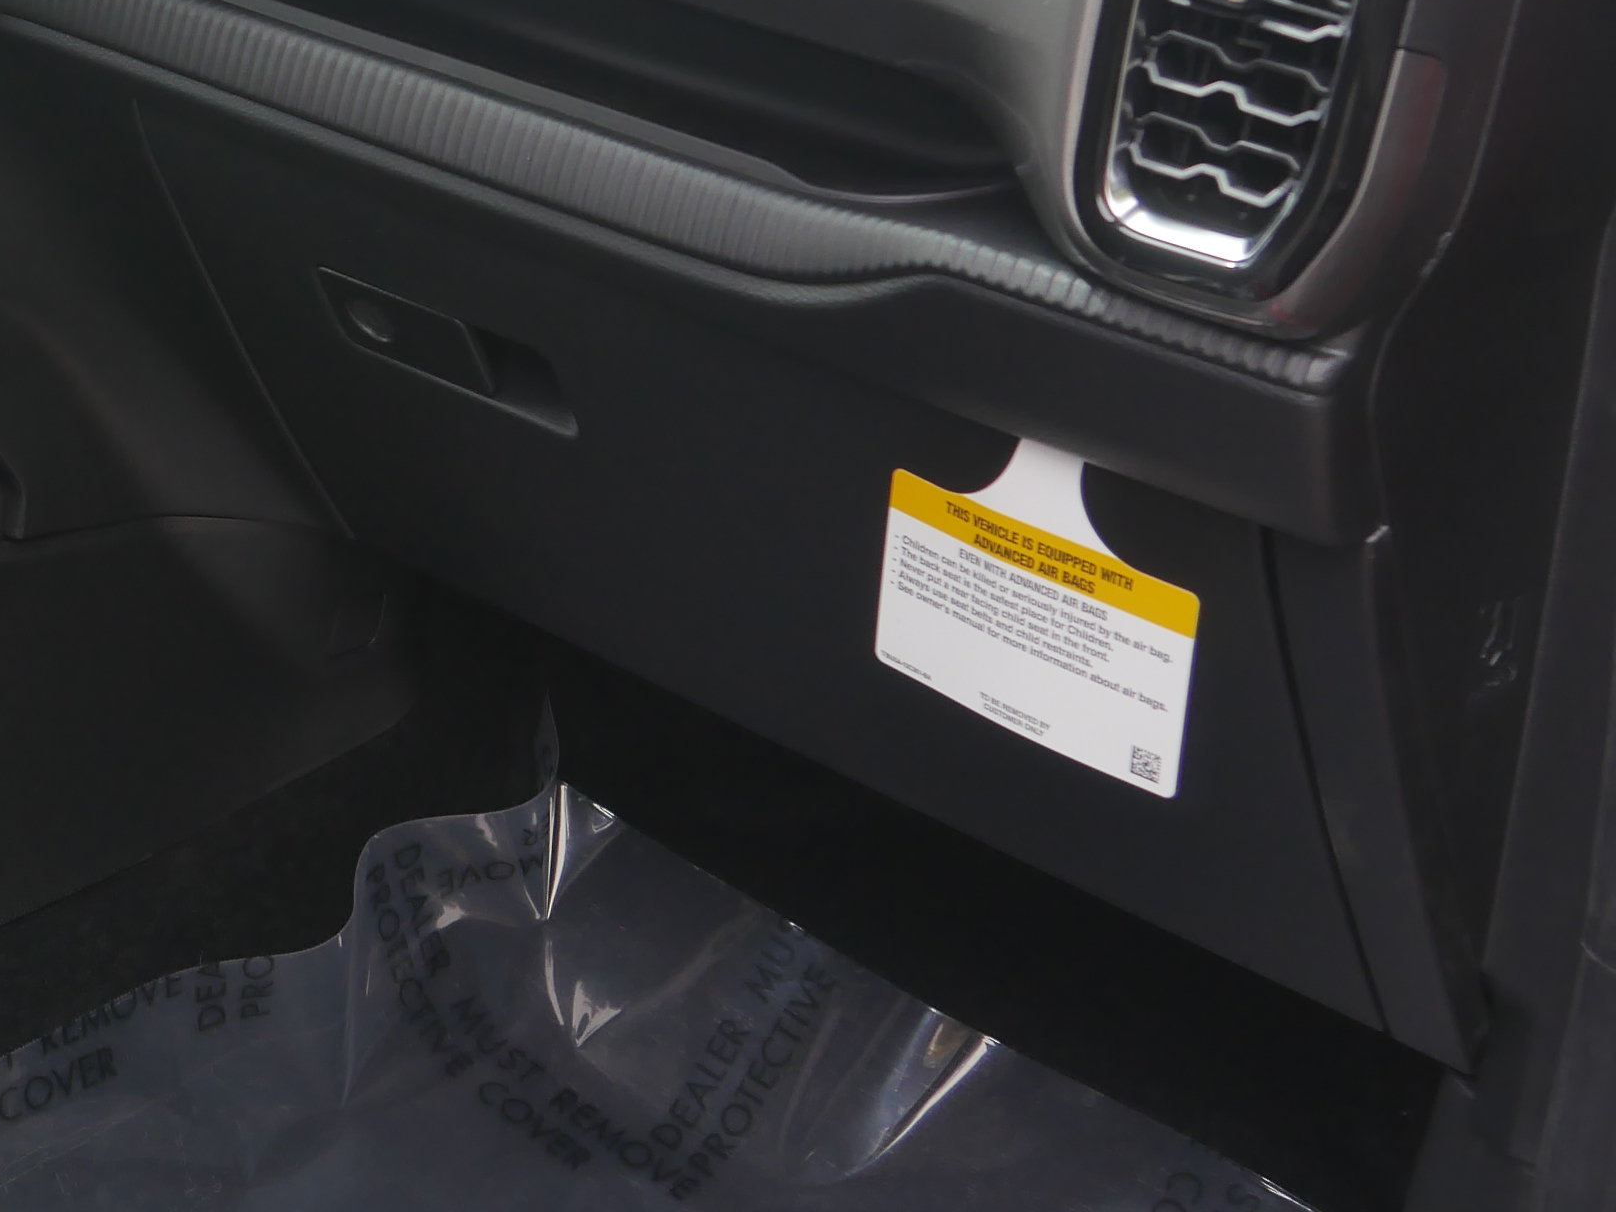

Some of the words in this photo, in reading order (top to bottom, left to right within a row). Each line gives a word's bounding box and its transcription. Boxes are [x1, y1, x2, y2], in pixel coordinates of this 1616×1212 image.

[902, 535, 940, 559] Children
[942, 556, 958, 569] can
[960, 563, 971, 576] be
[973, 571, 998, 590] killed
[999, 583, 1010, 594] or
[1012, 590, 1058, 618] seriously
[1060, 607, 1097, 632] injured
[1099, 625, 1112, 639] by
[1114, 631, 1132, 645] the
[1133, 640, 1148, 653] air
[1149, 646, 1174, 664] bag.
[902, 546, 918, 562] The
[920, 556, 940, 573] back
[943, 568, 962, 583] seat
[964, 579, 971, 589] is
[973, 583, 989, 597] the
[990, 591, 1020, 611] safest
[1021, 605, 1048, 624] place
[1051, 616, 1067, 631] for
[1067, 625, 1115, 653] Children.
[946, 501, 970, 523] THIS
[973, 514, 1020, 545] VEHICLE
[1022, 536, 1035, 550] IS
[1037, 542, 1097, 576] EQUIPPED
[1101, 567, 1134, 591] WITH
[959, 548, 981, 566] EVEN
[984, 560, 1007, 579] WITH
[1009, 573, 1060, 601] ADVANCED
[1062, 594, 1079, 610] AIR
[1082, 601, 1109, 622] BAGS
[974, 534, 1035, 569] ADVANCED
[1039, 562, 1059, 579] AIR
[1062, 570, 1097, 595] BAGS
[898, 570, 930, 593] Always
[932, 587, 950, 602] use
[951, 597, 970, 612] seat
[971, 607, 994, 624] belts
[995, 619, 1014, 633] and
[1016, 628, 1041, 645] child
[1042, 640, 1094, 669] restraints.
[898, 581, 915, 597] See
[916, 592, 950, 615] owner's
[952, 610, 985, 633] manual
[987, 626, 1001, 639] for
[1003, 635, 1027, 652] more
[1030, 647, 1088, 679] information
[1090, 672, 1121, 693] about
[1122, 686, 1137, 699] air
[1139, 692, 1169, 713] bags.
[900, 558, 926, 577] Never
[928, 573, 943, 587] put
[944, 582, 950, 590] a
[951, 586, 971, 599] rear
[971, 594, 1000, 617] facing
[1001, 608, 1026, 627] child
[1028, 621, 1049, 637] seat
[1051, 630, 1062, 642] in
[1063, 635, 1081, 650] the
[1082, 644, 1111, 663] front.
[364, 865, 476, 1080] PROTECTIVE
[477, 1080, 593, 1172] COVER
[392, 842, 452, 979] DEALER
[452, 996, 544, 1085] MUST
[547, 1087, 696, 1204] REMOVE
[694, 960, 838, 1177] PROTECTIVE
[651, 1017, 752, 1152] DEALER
